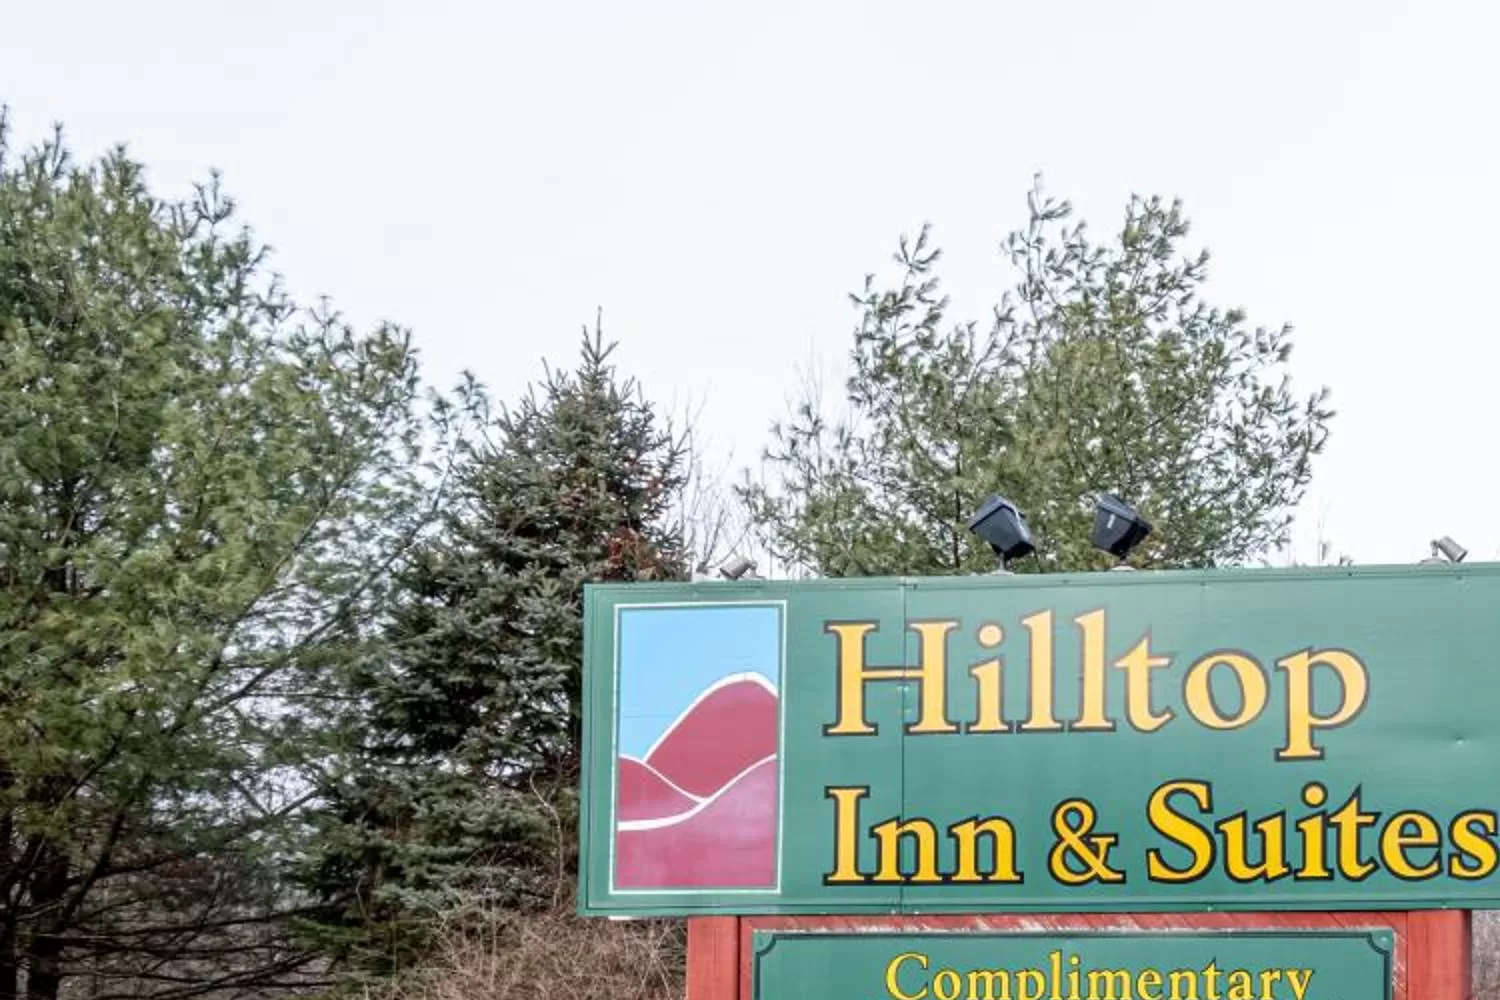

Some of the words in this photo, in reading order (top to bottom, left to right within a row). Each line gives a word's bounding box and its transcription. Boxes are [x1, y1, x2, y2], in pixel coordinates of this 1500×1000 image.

[823, 605, 1369, 762] Hilltop
[823, 784, 1025, 887] Inn
[1046, 797, 1127, 887] &
